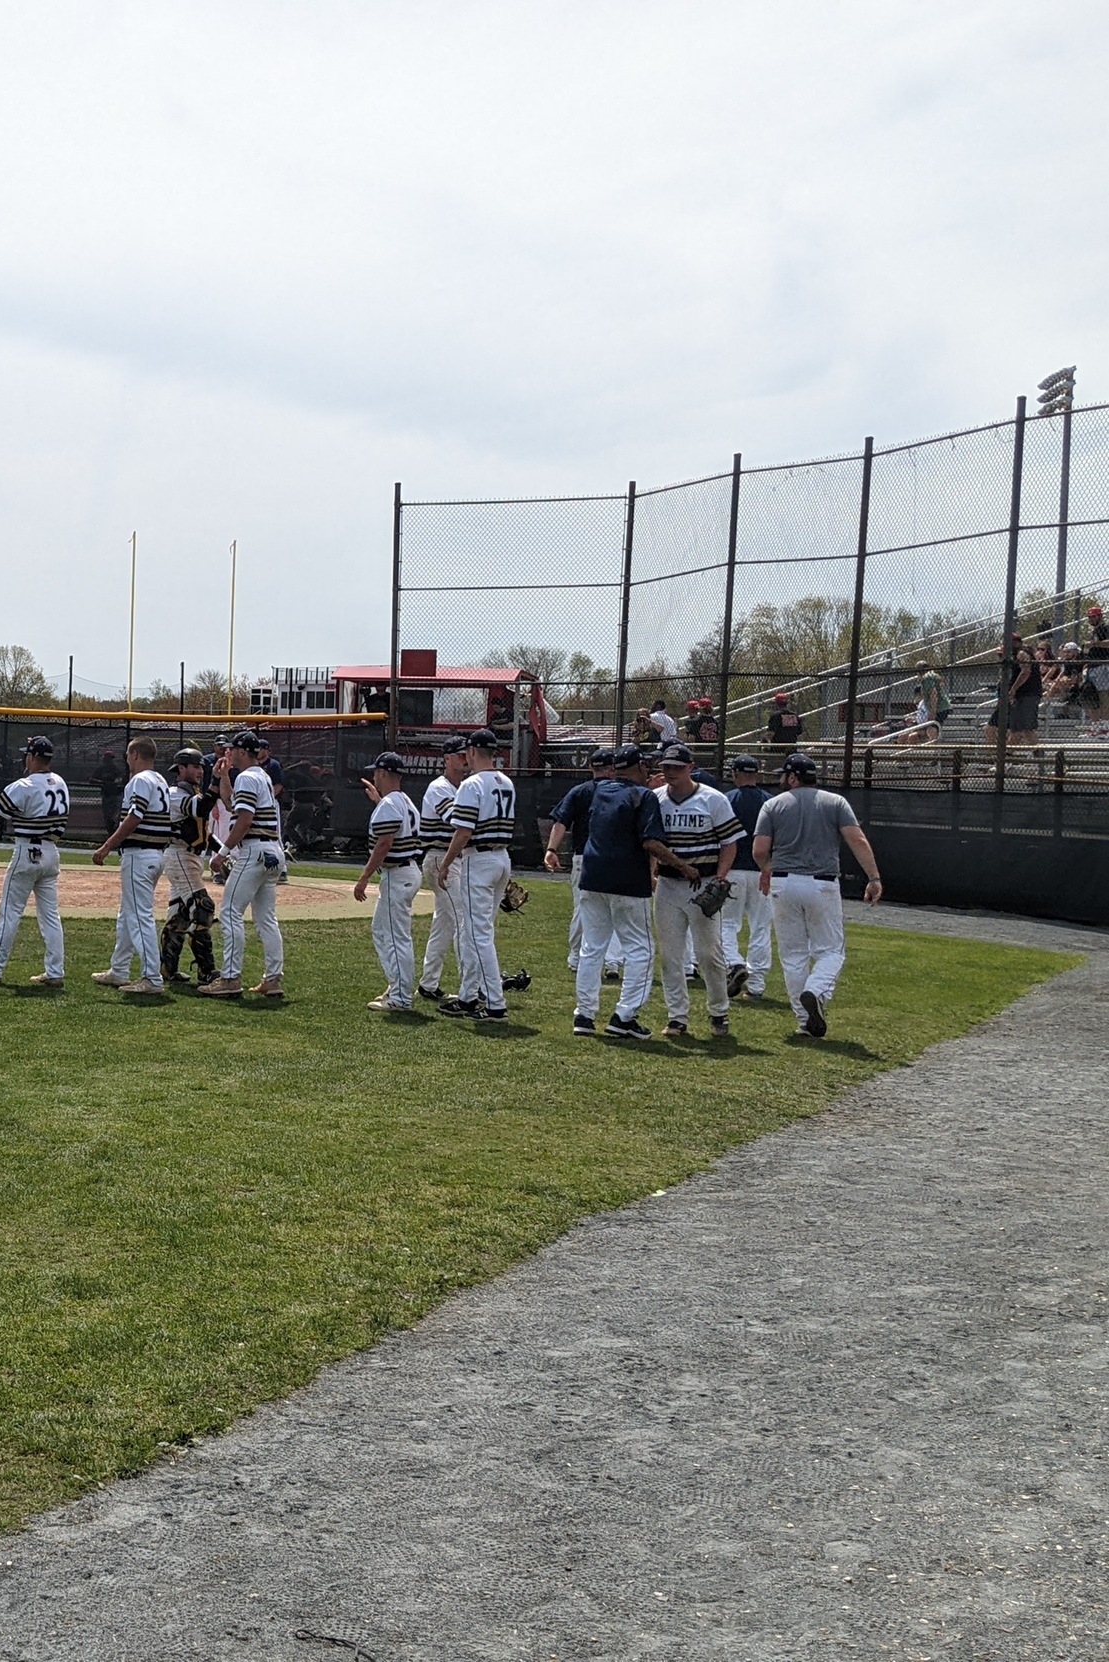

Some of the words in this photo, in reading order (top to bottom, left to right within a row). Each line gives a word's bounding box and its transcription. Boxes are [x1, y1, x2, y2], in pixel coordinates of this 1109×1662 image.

[44, 788, 68, 816] 23
[156, 785, 170, 813] 3
[492, 788, 512, 819] 37
[664, 813, 705, 828] RITIME
